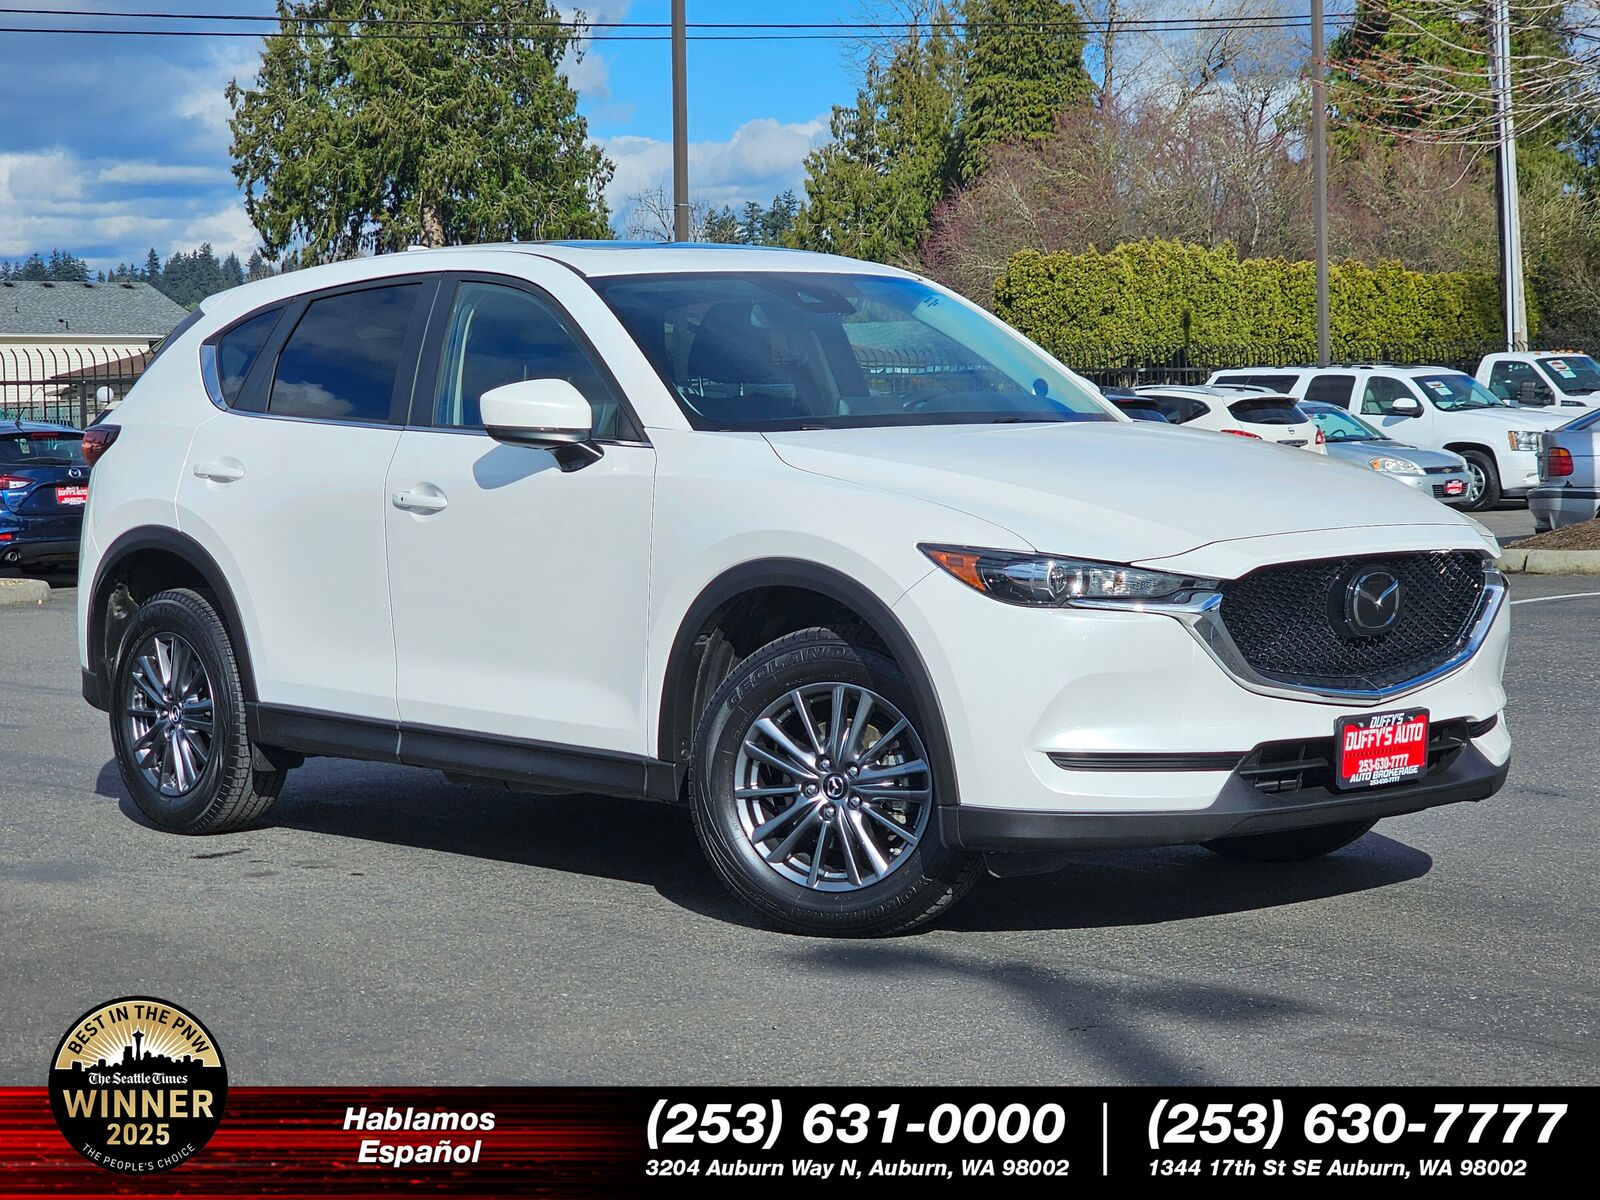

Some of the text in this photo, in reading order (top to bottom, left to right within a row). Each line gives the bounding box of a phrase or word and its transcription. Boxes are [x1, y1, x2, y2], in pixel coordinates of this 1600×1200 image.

[1370, 713, 1405, 728] DUFFY'S
[1345, 722, 1424, 751] DUFFY'S AUTO
[1358, 753, 1409, 773] 253-630-7777
[1349, 765, 1419, 783] AUTO BROKERAGE
